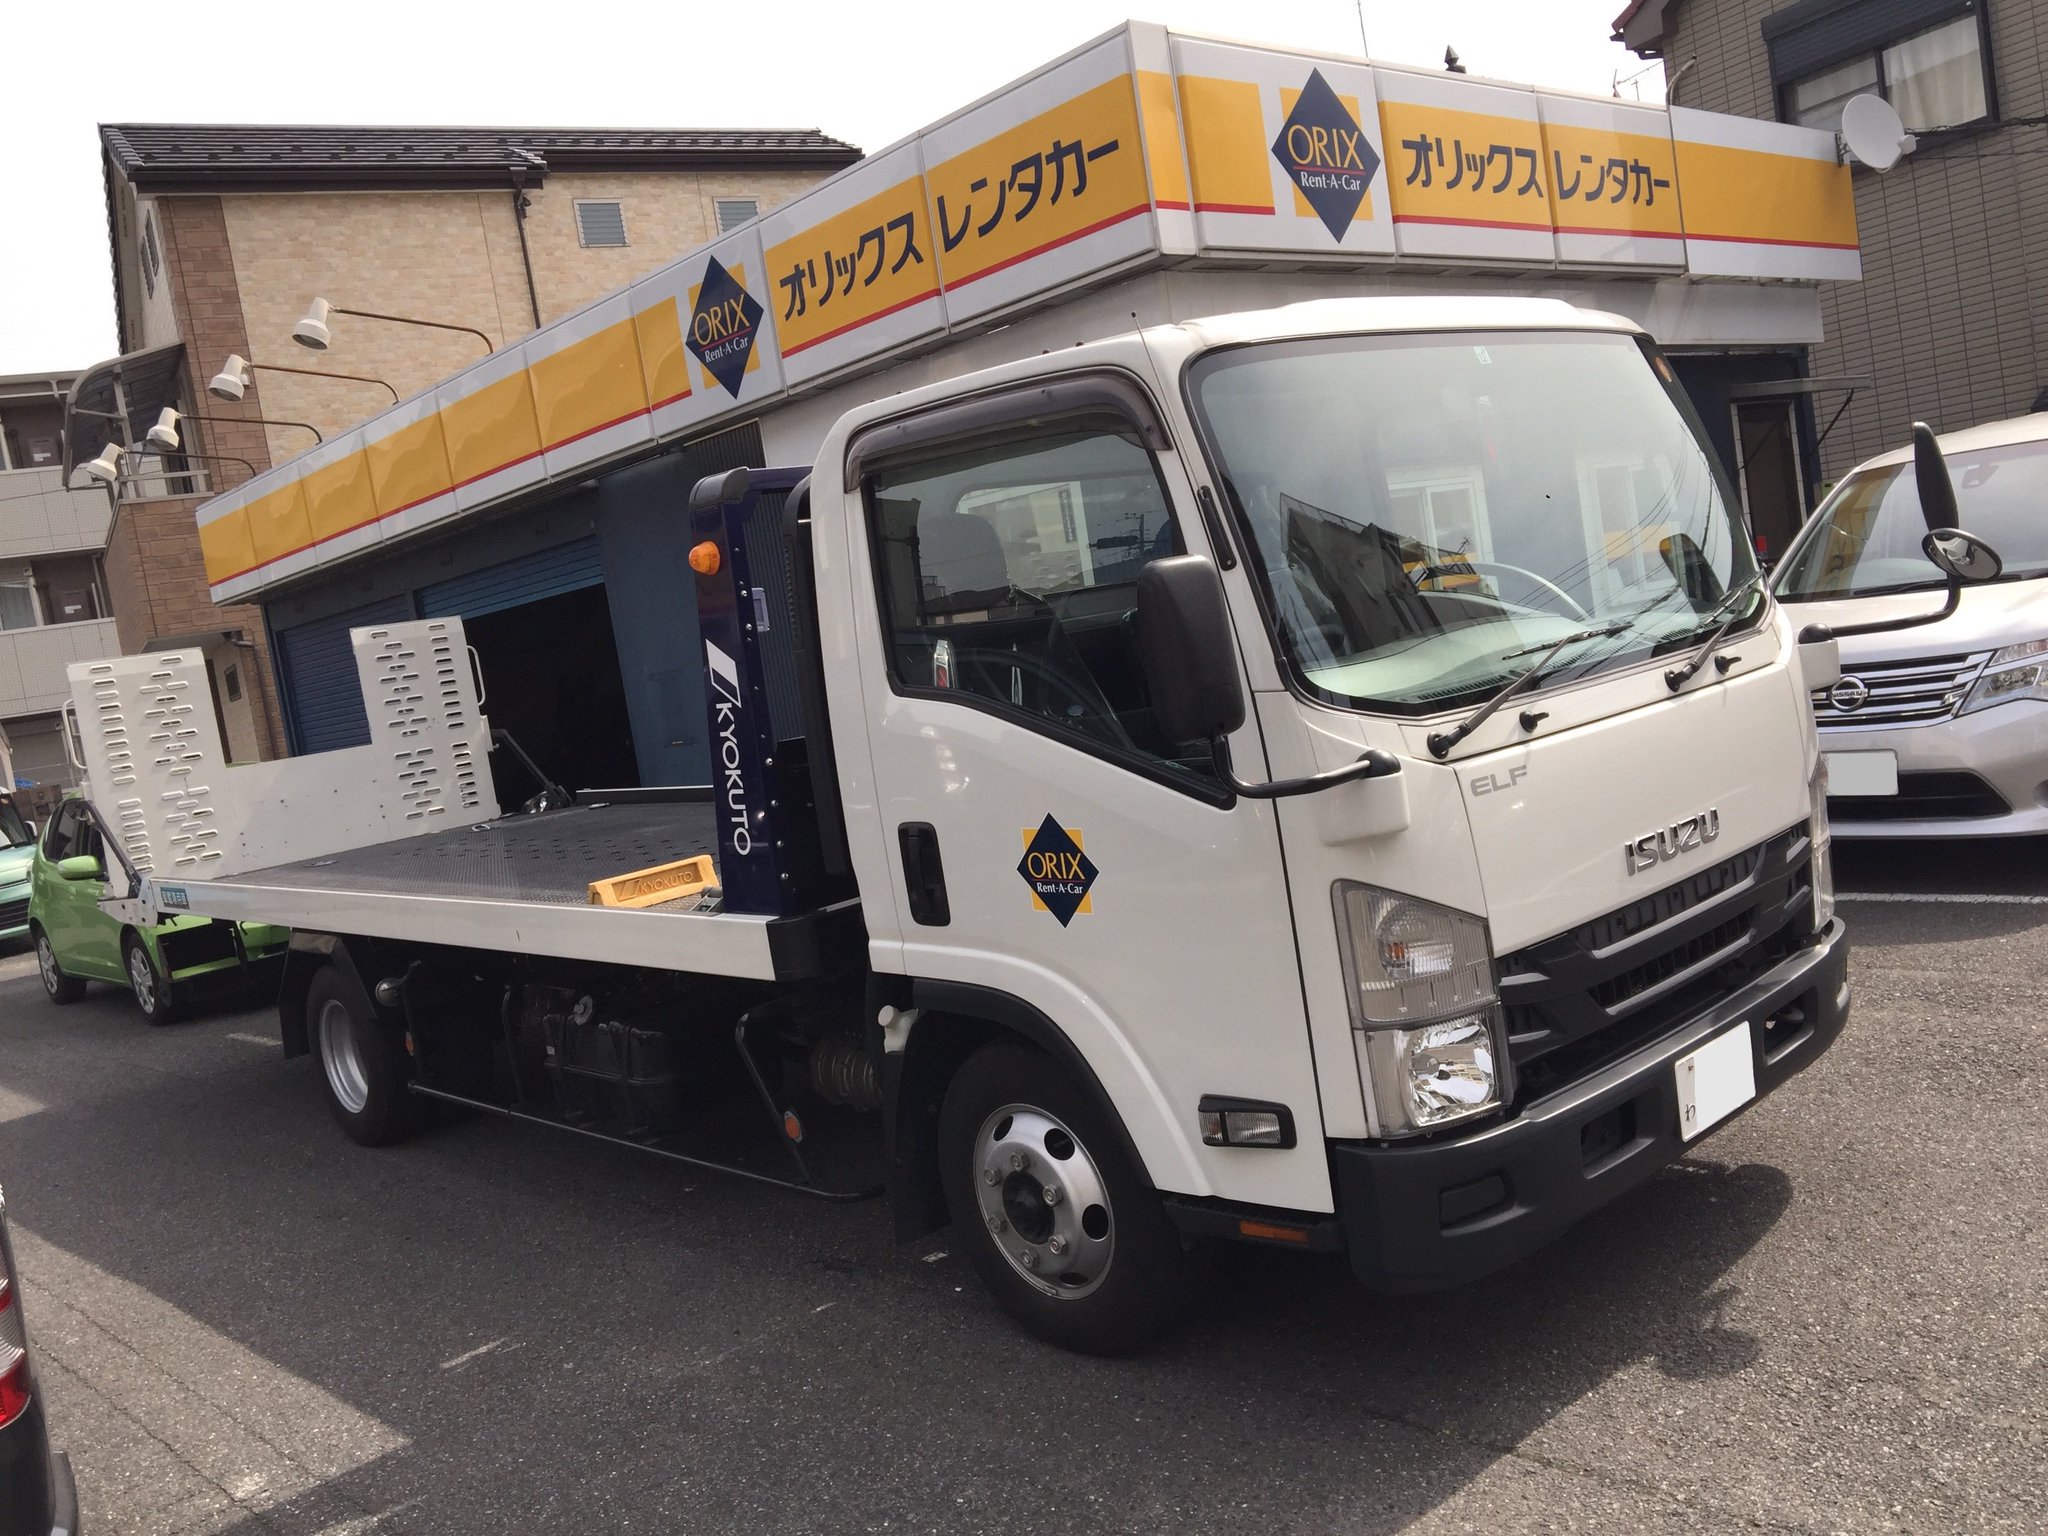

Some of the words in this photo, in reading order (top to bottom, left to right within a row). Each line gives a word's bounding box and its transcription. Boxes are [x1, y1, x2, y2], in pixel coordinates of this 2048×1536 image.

[1287, 124, 1364, 170] ORIX
[1300, 171, 1361, 191] Rent-A-Car
[1402, 133, 1544, 198] オリックス
[1554, 150, 1670, 206] レンタカー
[779, 211, 924, 322] オリックス
[937, 140, 1120, 253] レンタカー
[694, 293, 750, 346] ORIX
[704, 336, 749, 364] Rent-A-Car
[715, 702, 751, 856] KYOKUTO
[1470, 764, 1528, 797] ELF
[1624, 807, 1720, 877] ISUZU
[640, 871, 694, 893] KYOKUTO
[1027, 852, 1086, 880] ORIX
[1036, 882, 1084, 894] Rent-A-Car
